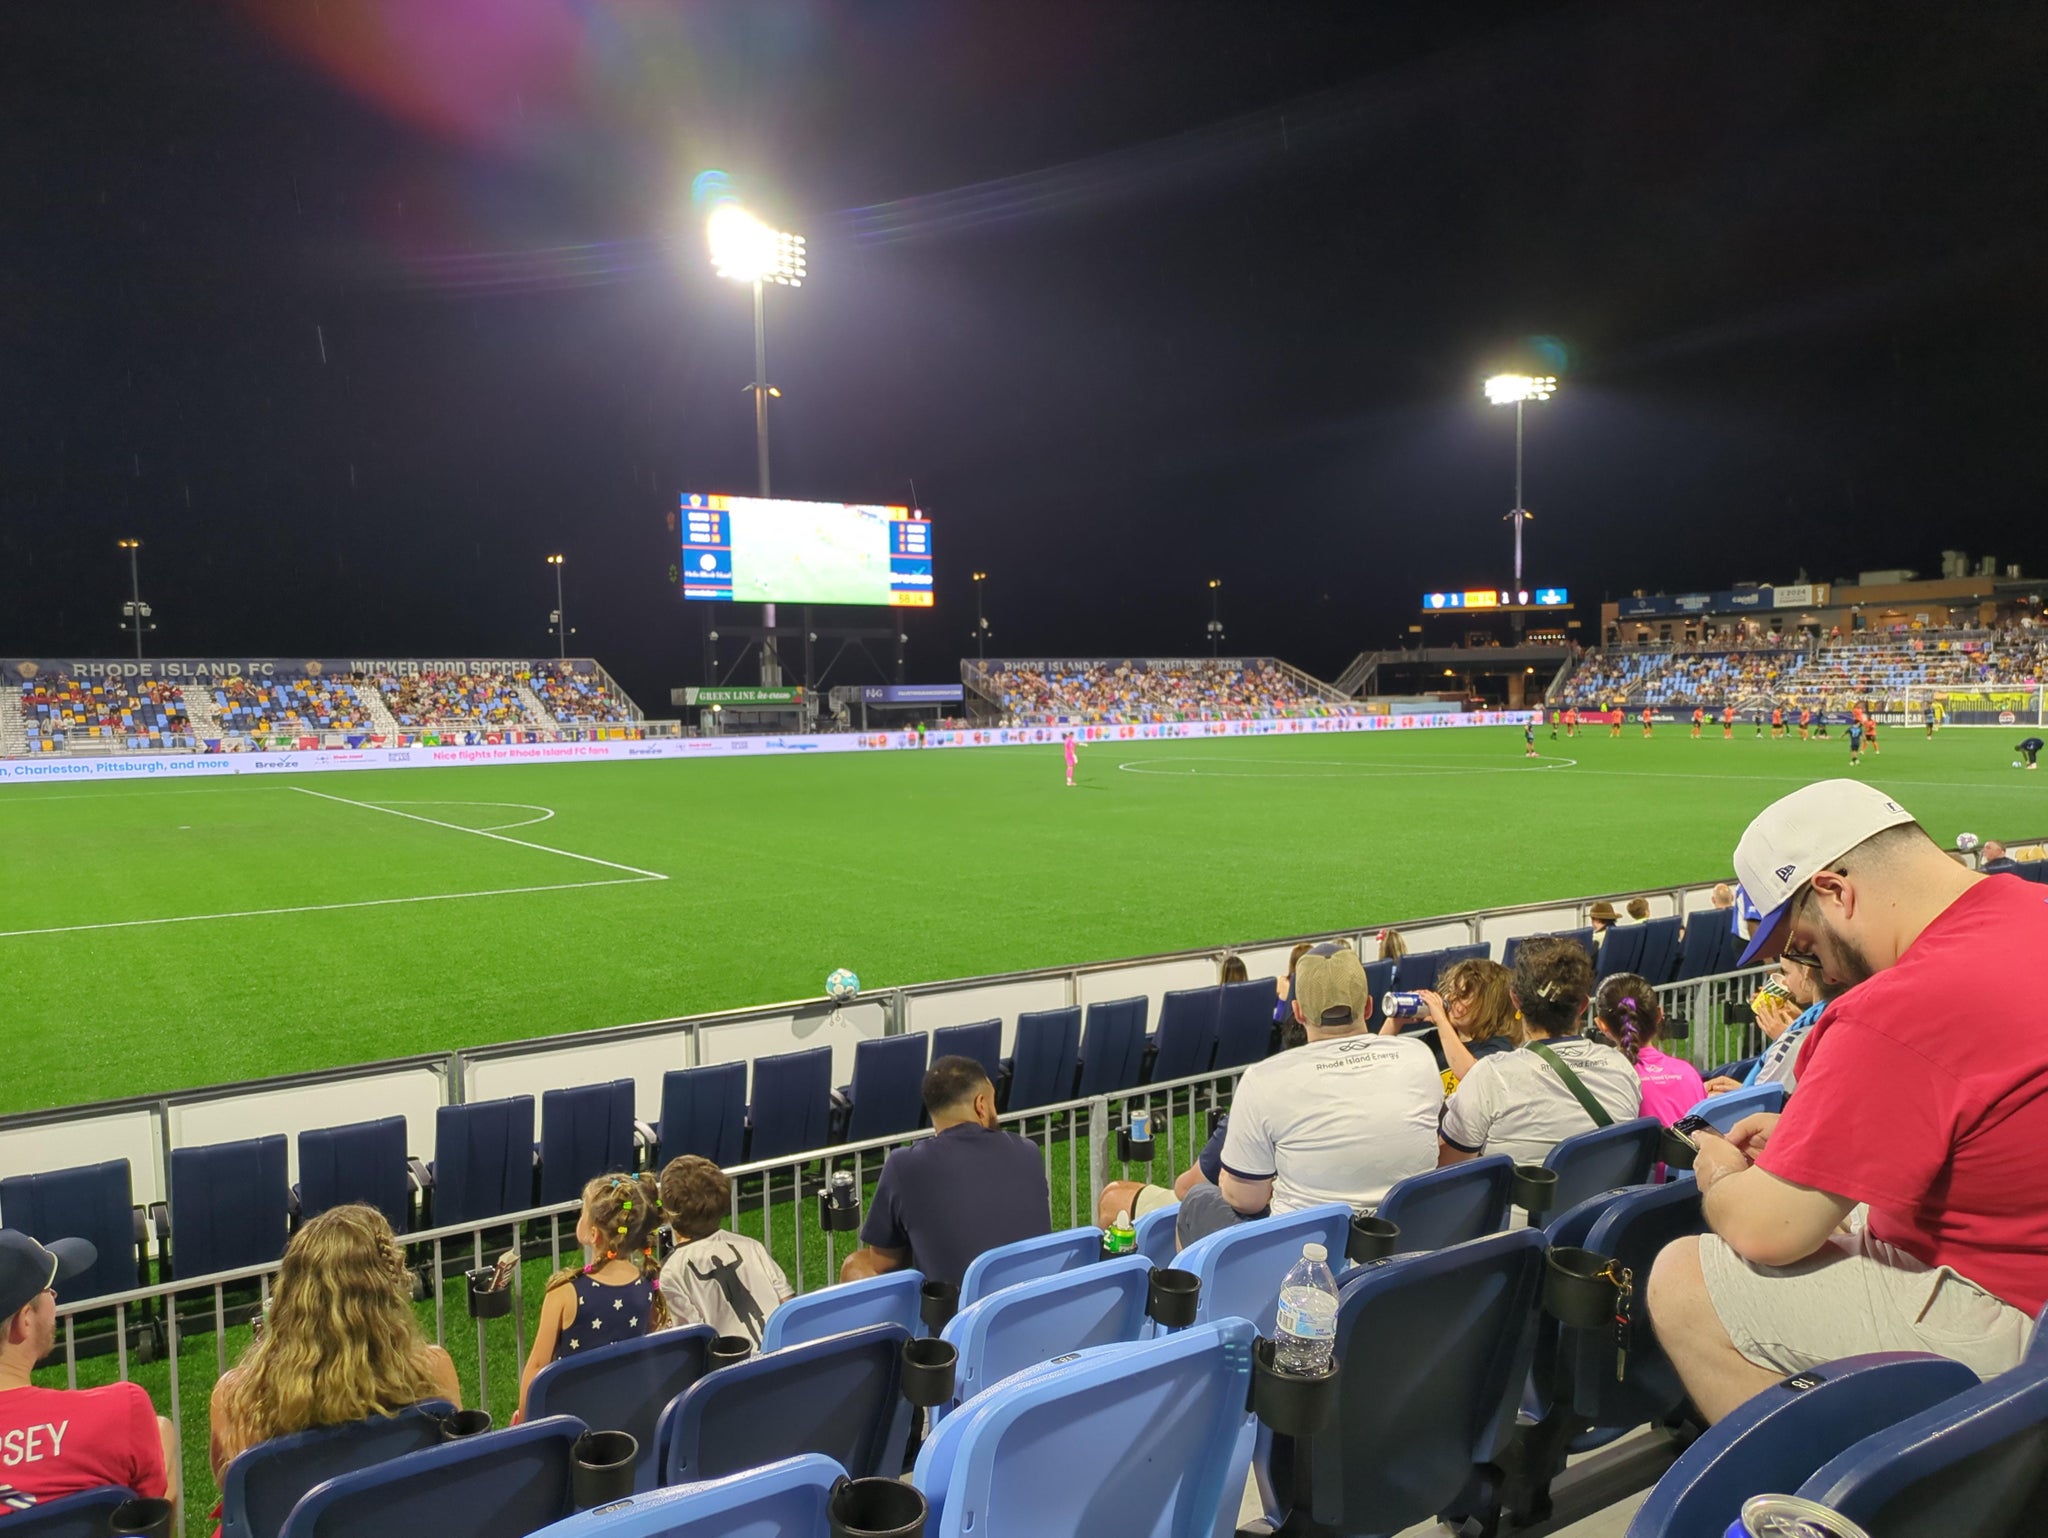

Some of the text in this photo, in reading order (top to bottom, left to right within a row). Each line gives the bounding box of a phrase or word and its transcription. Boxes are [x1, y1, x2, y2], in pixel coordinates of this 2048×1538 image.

[73, 662, 275, 677] RHODE ISLAND FC
[350, 661, 418, 677] WICKED
[422, 661, 467, 676] GOOD
[1003, 661, 1045, 673] RHODE
[698, 691, 731, 701] GREEN
[733, 691, 755, 700] LINE
[433, 745, 609, 761] Nice flights for Rhode Island FC fans
[14, 763, 94, 776] Charleston,
[96, 759, 168, 774] Pittsburgh,
[170, 760, 196, 770] and
[197, 758, 230, 768] more
[255, 760, 299, 769] Breeze
[1316, 1060, 1345, 1071] Rhode
[1346, 1053, 1371, 1065] Island
[1372, 1051, 1400, 1061] Energy
[1584, 1058, 1609, 1068] Energy
[1791, 1377, 1815, 1389] 18
[0, 1420, 69, 1466] SEY
